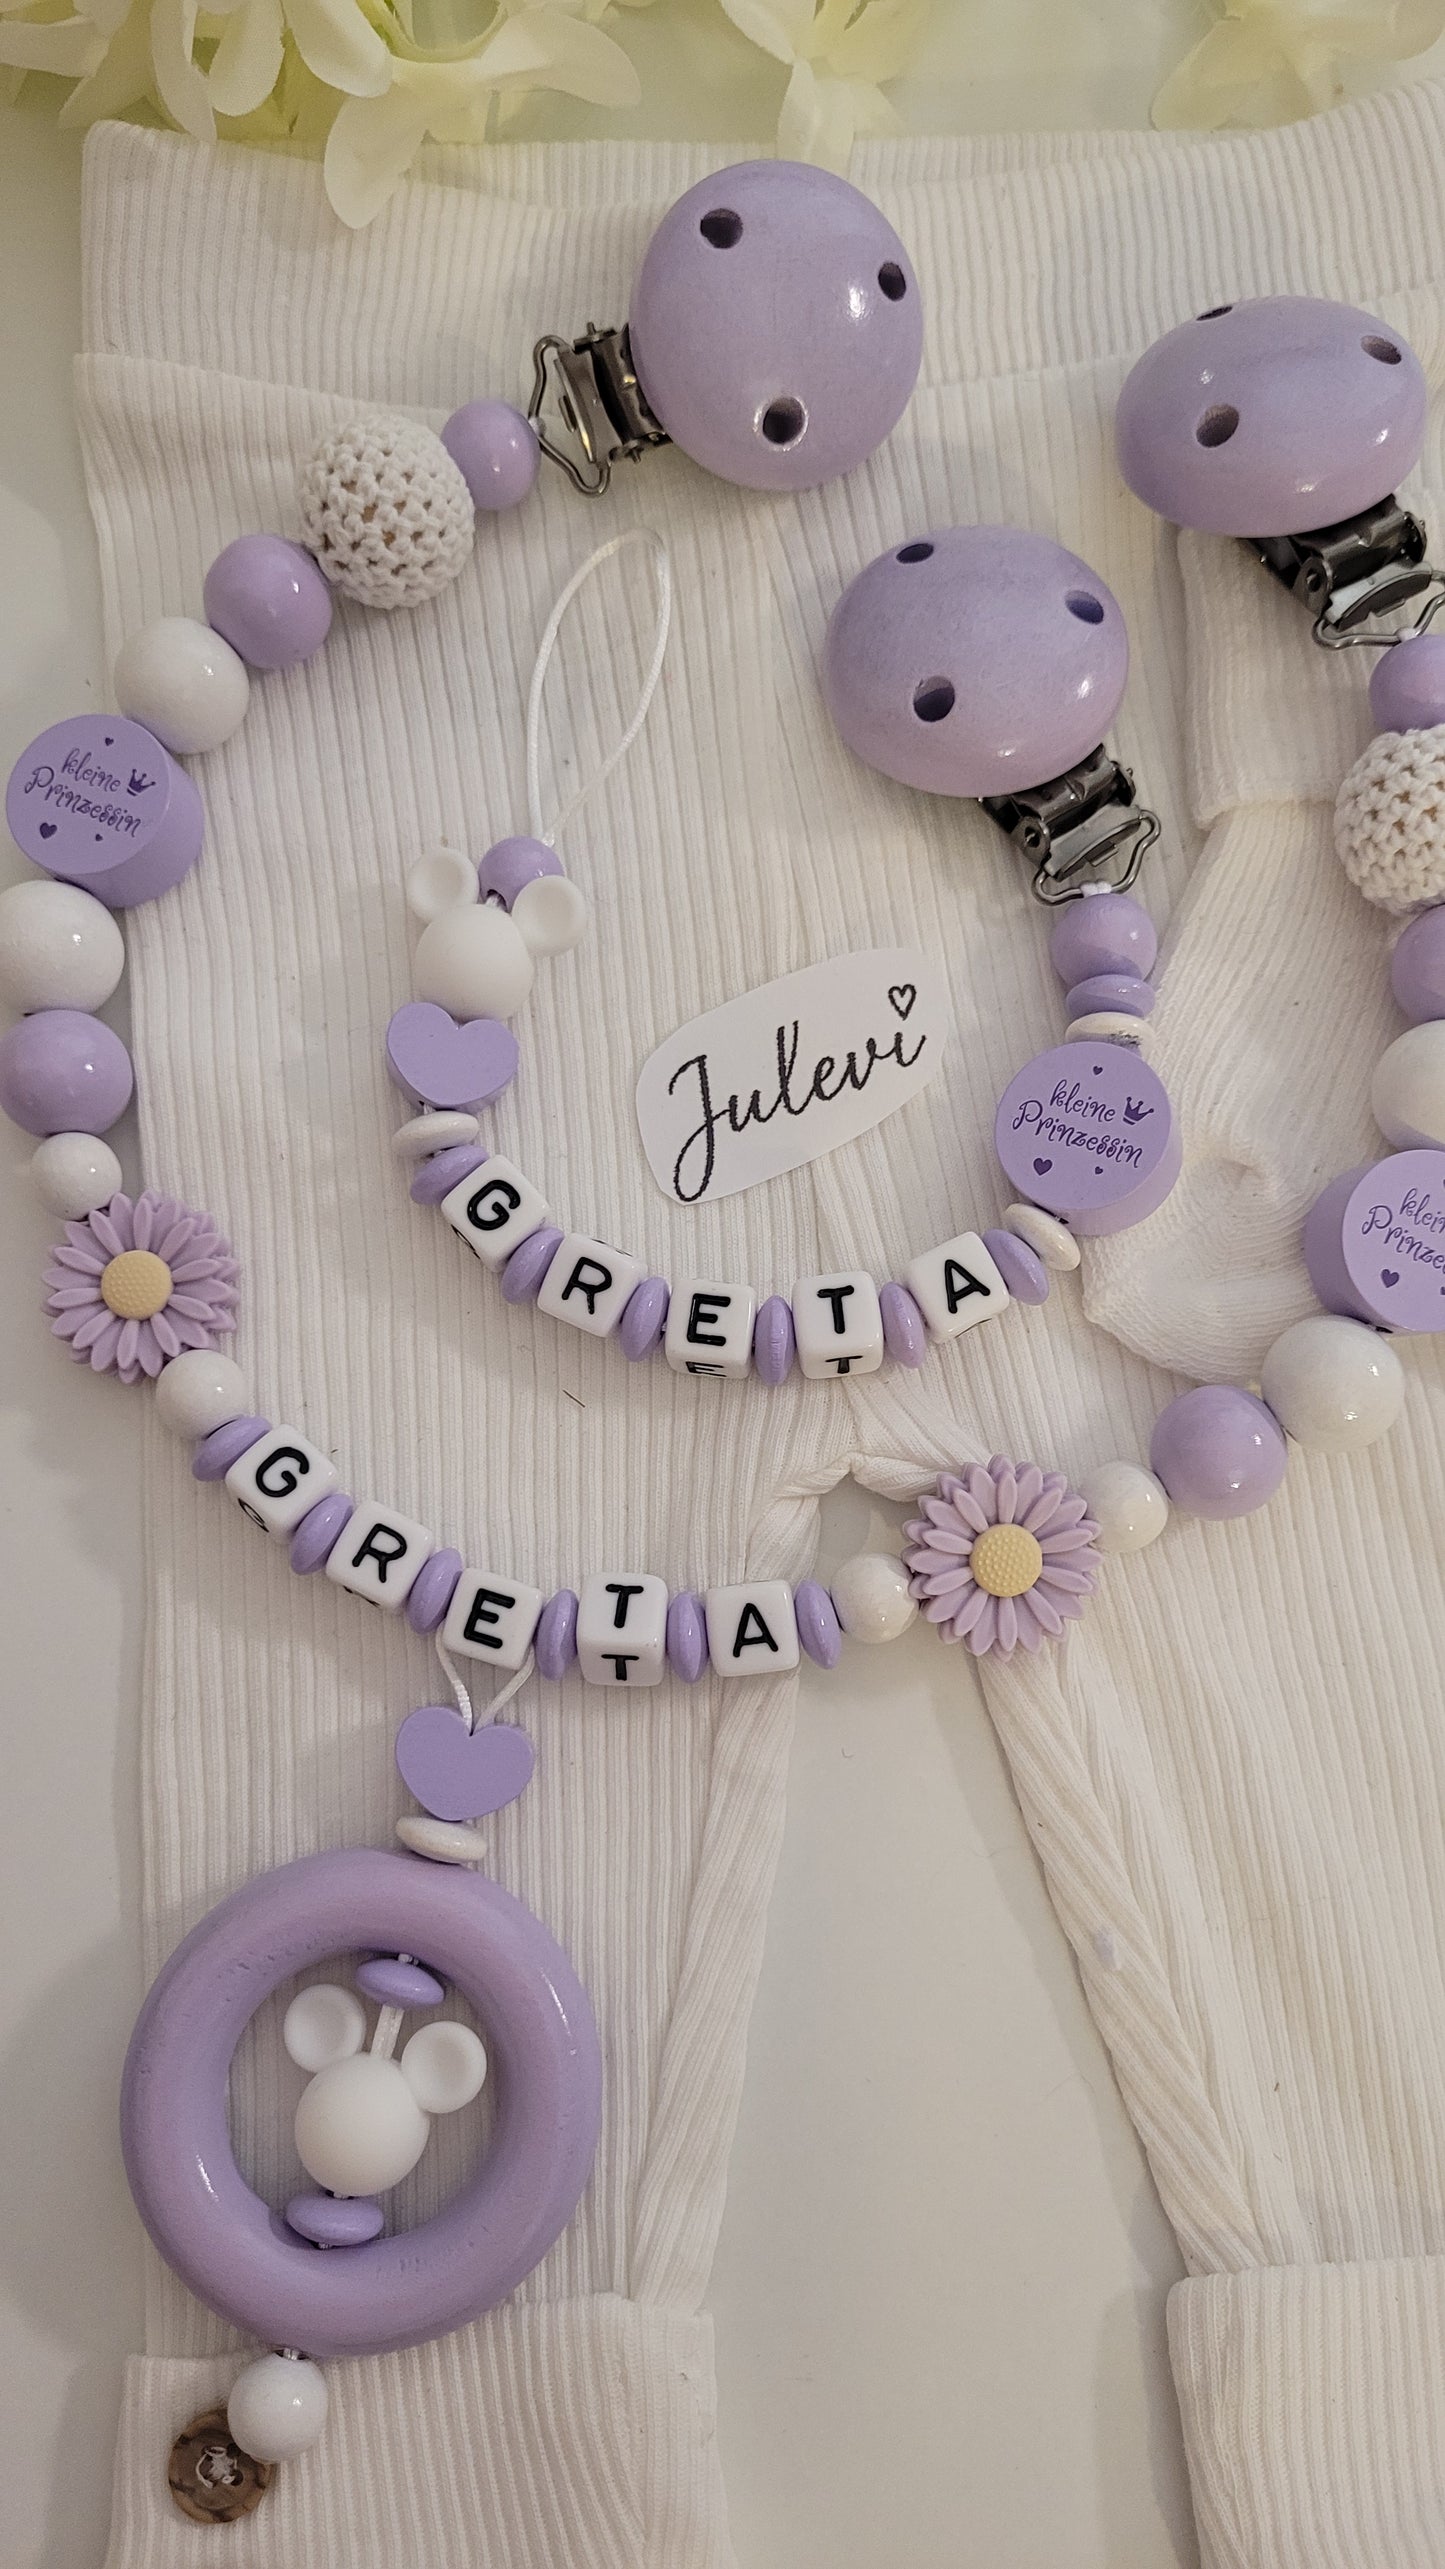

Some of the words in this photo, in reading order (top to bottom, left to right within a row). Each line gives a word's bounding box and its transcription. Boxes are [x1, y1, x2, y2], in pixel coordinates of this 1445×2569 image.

[24, 766, 141, 838] Prinzessin
[61, 748, 121, 793] kleine
[668, 984, 927, 1202] Julevi
[1050, 1079, 1116, 1122] kleine
[1012, 1100, 1143, 1168] Prinzessin
[466, 1179, 990, 1347] GRETA
[1361, 1205, 1445, 1275] Prinze
[256, 1446, 780, 1659] GRETA
